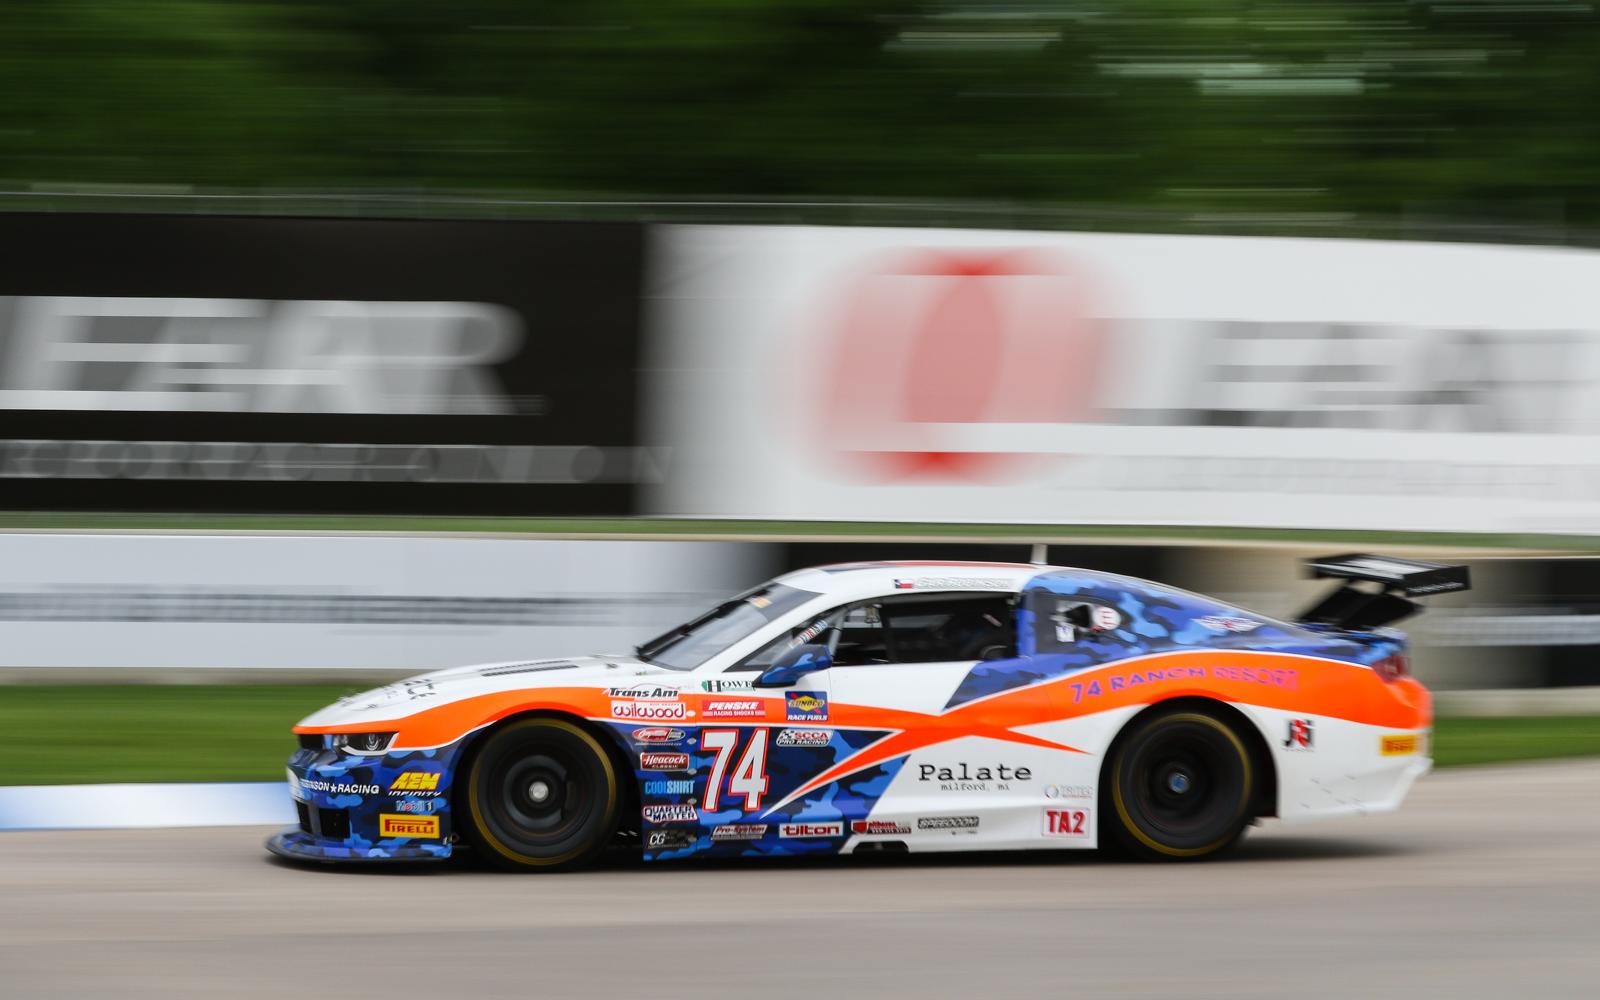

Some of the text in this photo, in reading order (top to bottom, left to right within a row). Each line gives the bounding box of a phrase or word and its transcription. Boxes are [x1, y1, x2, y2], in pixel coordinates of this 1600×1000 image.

[1071, 681, 1101, 703] 74
[1110, 668, 1205, 690] RANCH
[609, 688, 678, 698] Trans Am
[709, 702, 759, 710] PENSKE
[788, 700, 825, 708] SUNOCO
[614, 703, 684, 718] wilwood
[644, 755, 686, 765] Heacock
[701, 728, 769, 812] 74
[919, 763, 1031, 781] Palate
[390, 772, 441, 790] AEM
[645, 780, 695, 794] COOLSHIRT
[941, 783, 989, 791] milford,
[337, 784, 380, 794] RACING
[645, 805, 692, 816] QUARTER
[653, 812, 695, 821] MASTER
[385, 818, 434, 834] PIRELLI
[1047, 810, 1085, 833] TA2
[784, 824, 840, 836] tilton
[650, 833, 666, 845] CG
